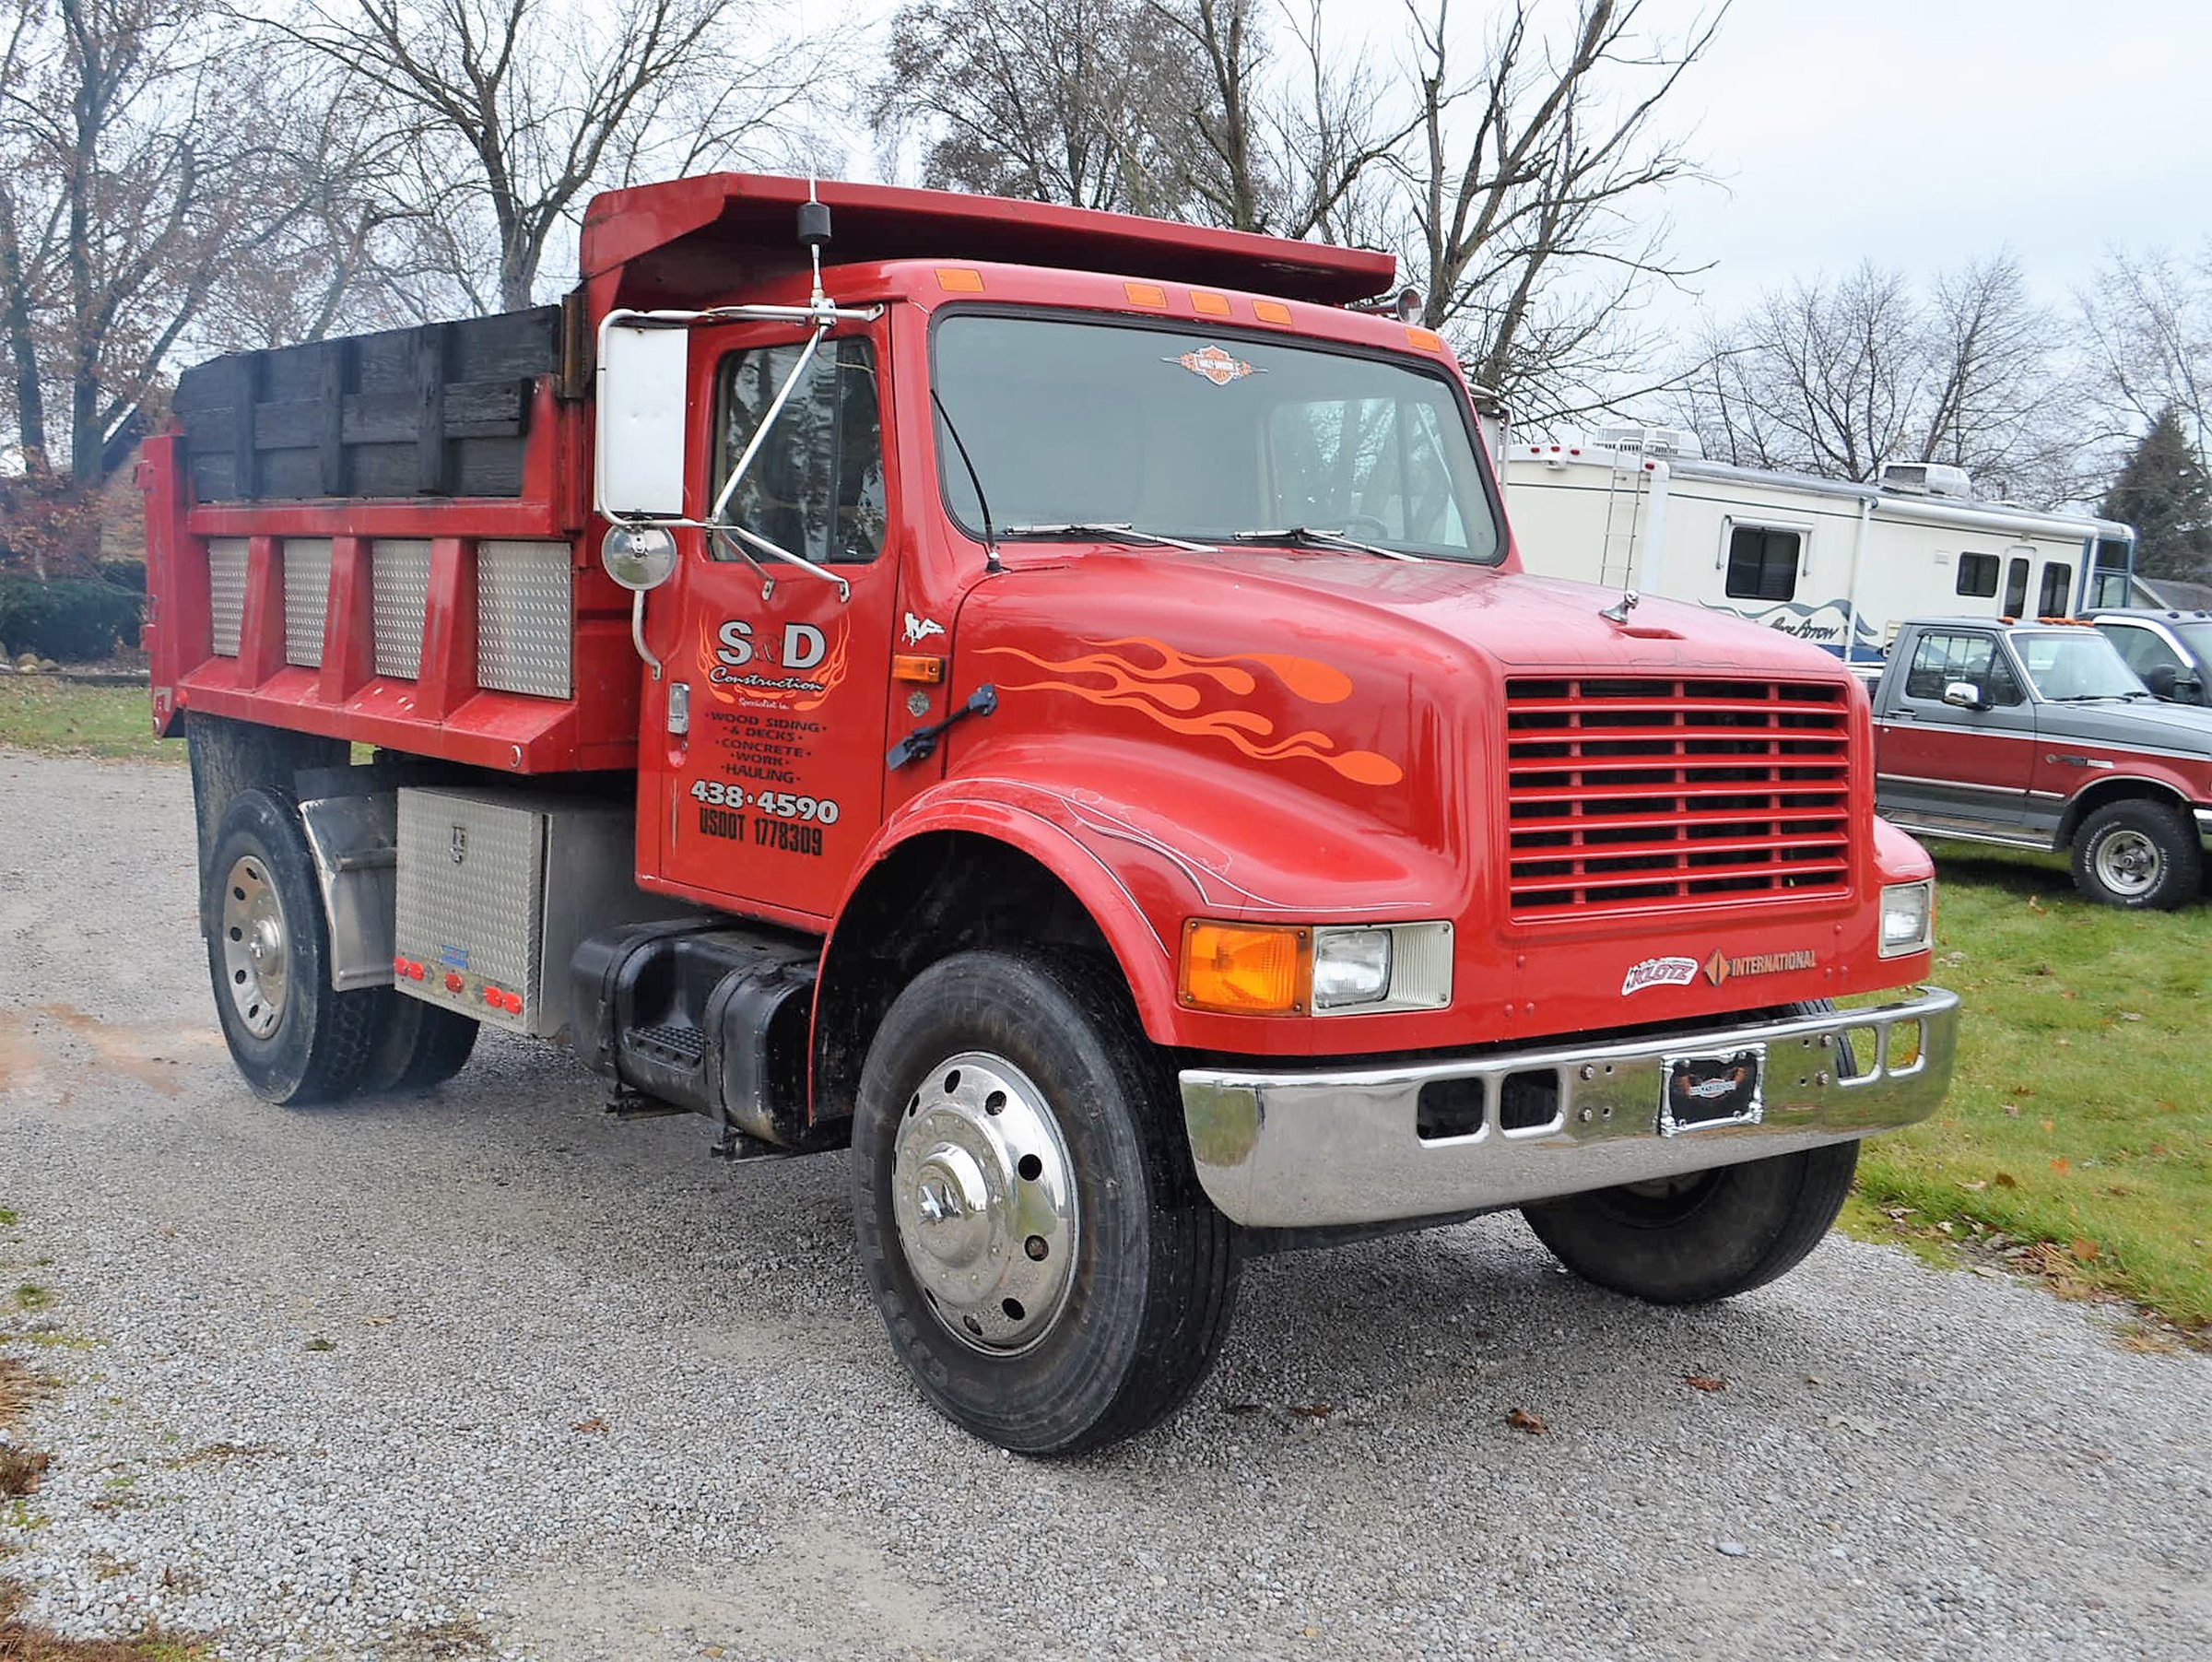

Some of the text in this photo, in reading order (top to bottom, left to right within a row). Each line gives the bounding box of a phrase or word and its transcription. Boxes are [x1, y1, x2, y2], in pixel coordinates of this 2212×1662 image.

[709, 666, 825, 691] Construction
[711, 712, 820, 733] WOOD SIDING
[746, 727, 795, 742] DECKS
[722, 738, 804, 758] CONCRETE
[736, 751, 783, 766] WORK
[725, 763, 794, 784] HAULING
[699, 807, 823, 856] USDOT 1778309
[1731, 950, 1817, 977] INTERNATIONAL
